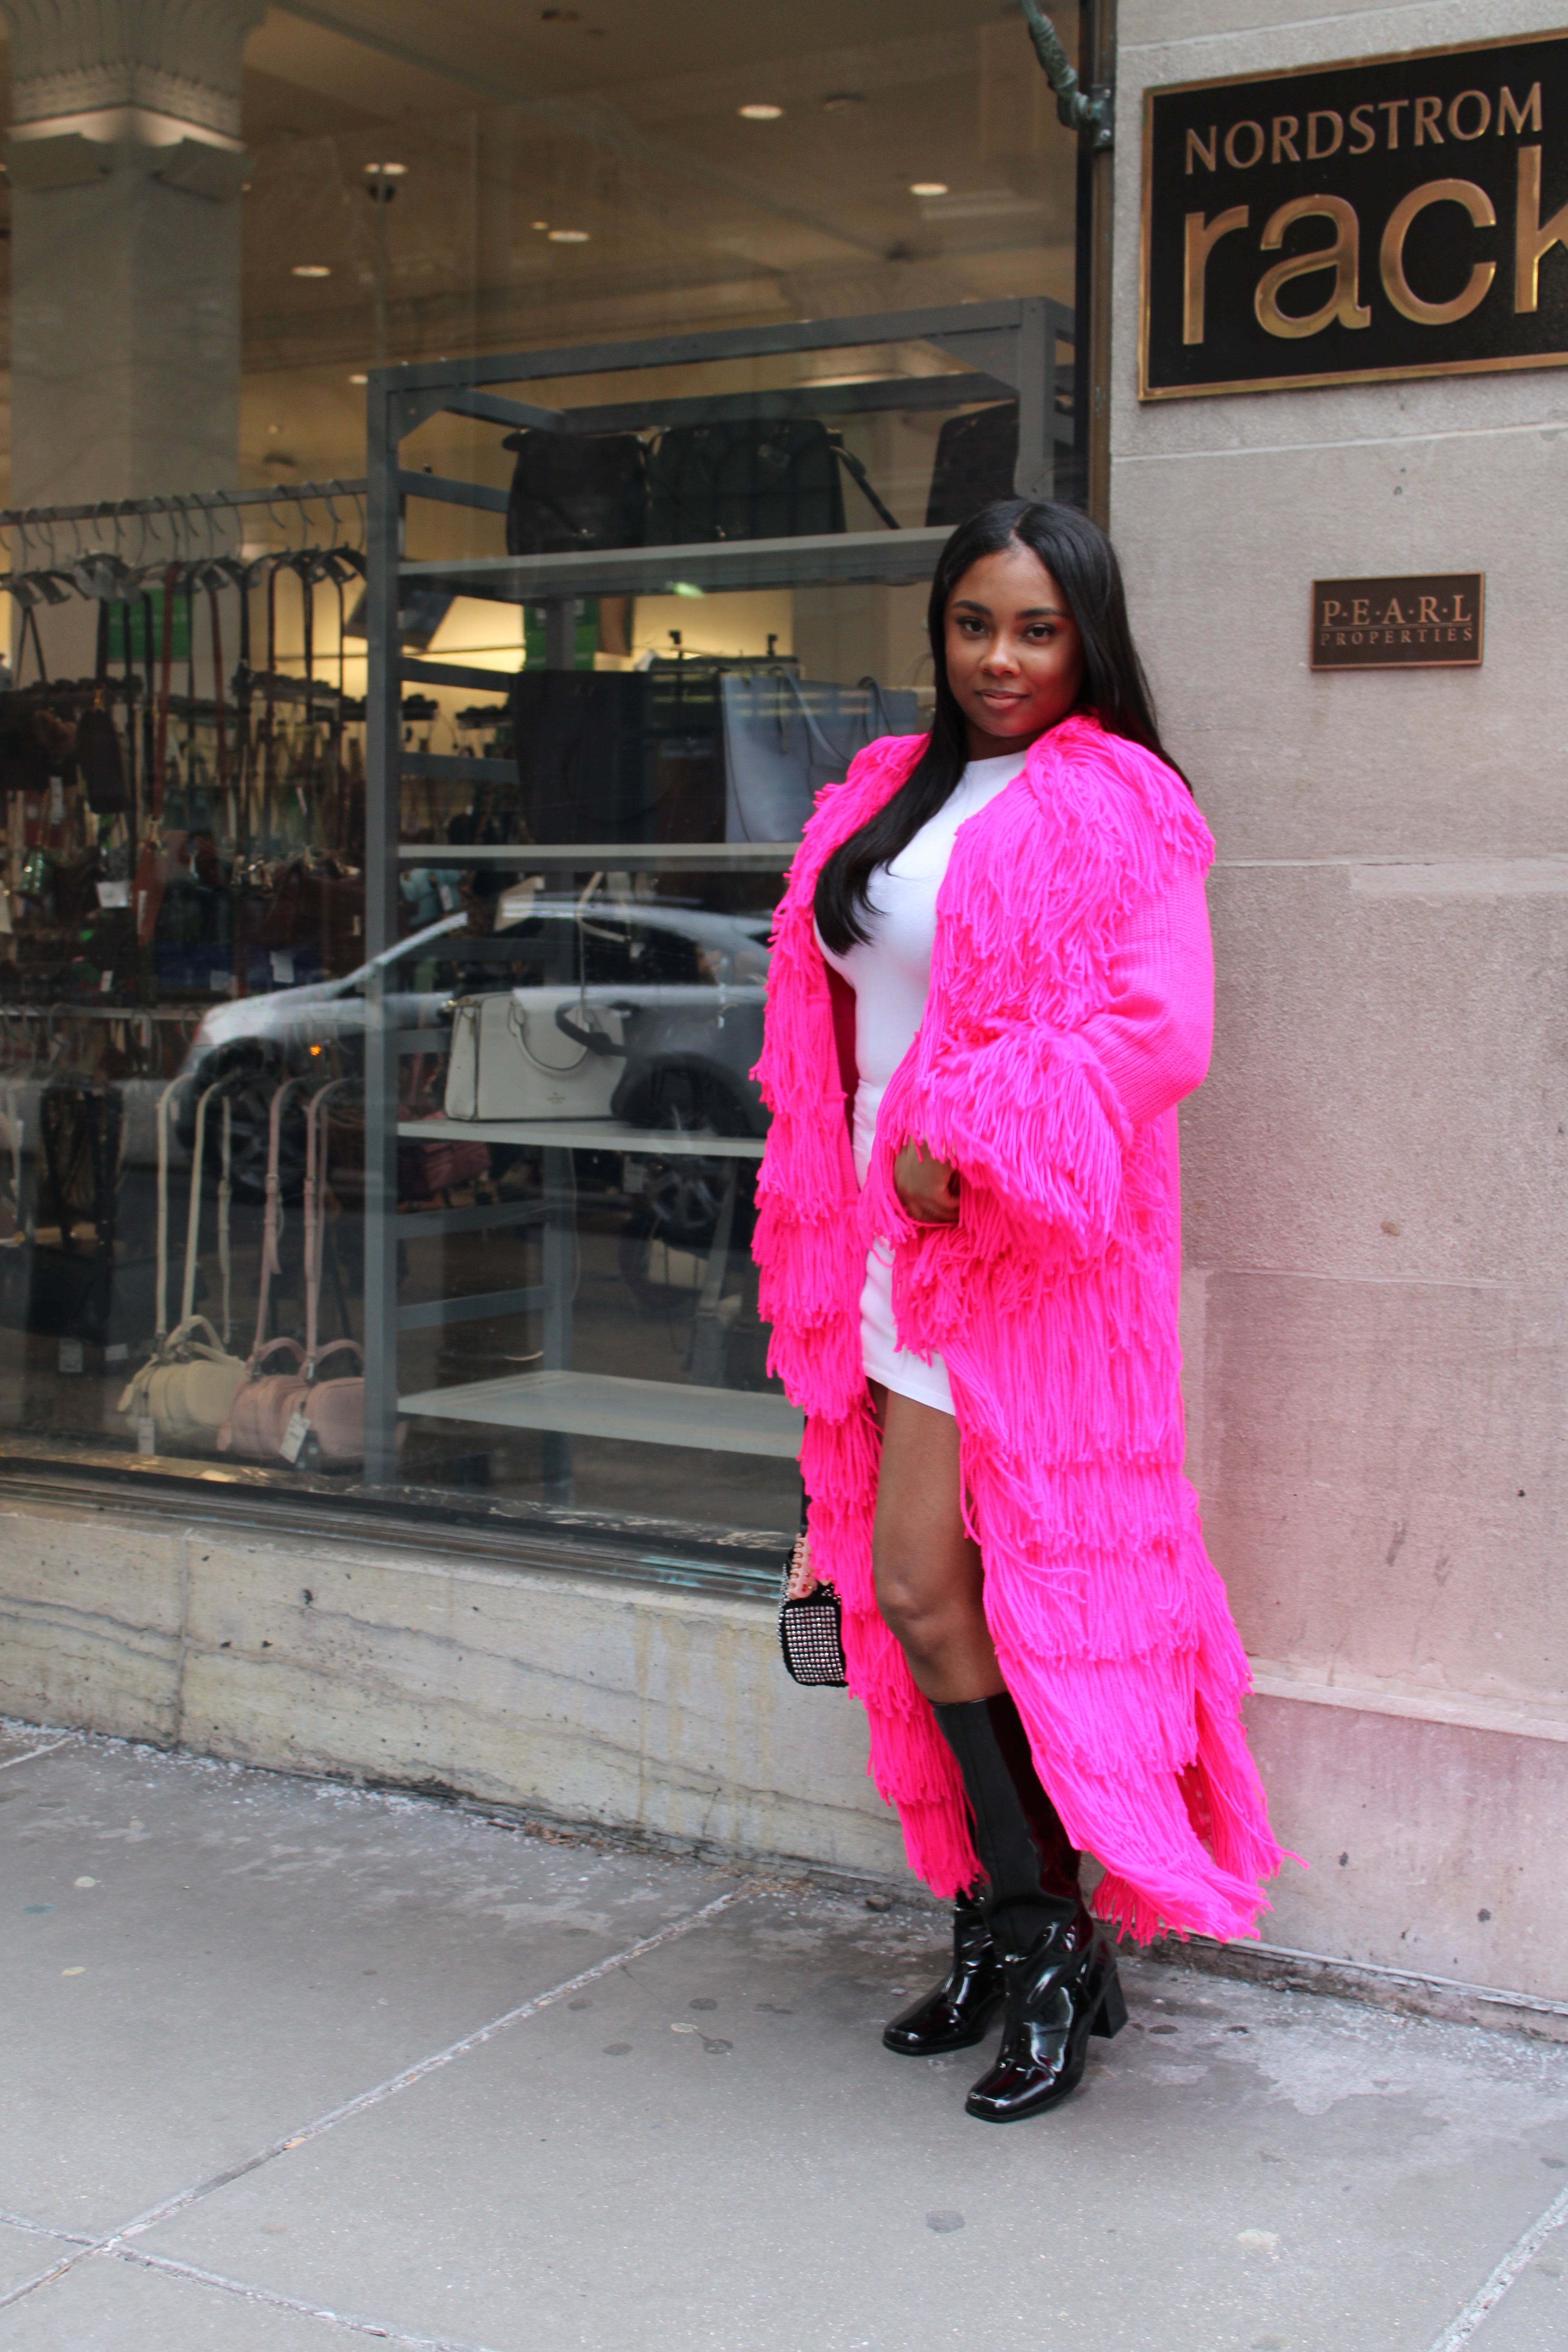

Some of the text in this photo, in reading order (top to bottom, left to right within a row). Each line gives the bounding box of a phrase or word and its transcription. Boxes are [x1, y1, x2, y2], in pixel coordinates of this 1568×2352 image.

[1185, 82, 1542, 175] NORDSTROM
[1183, 145, 1568, 345] rack
[1321, 627, 1473, 646] PROPERTIES
